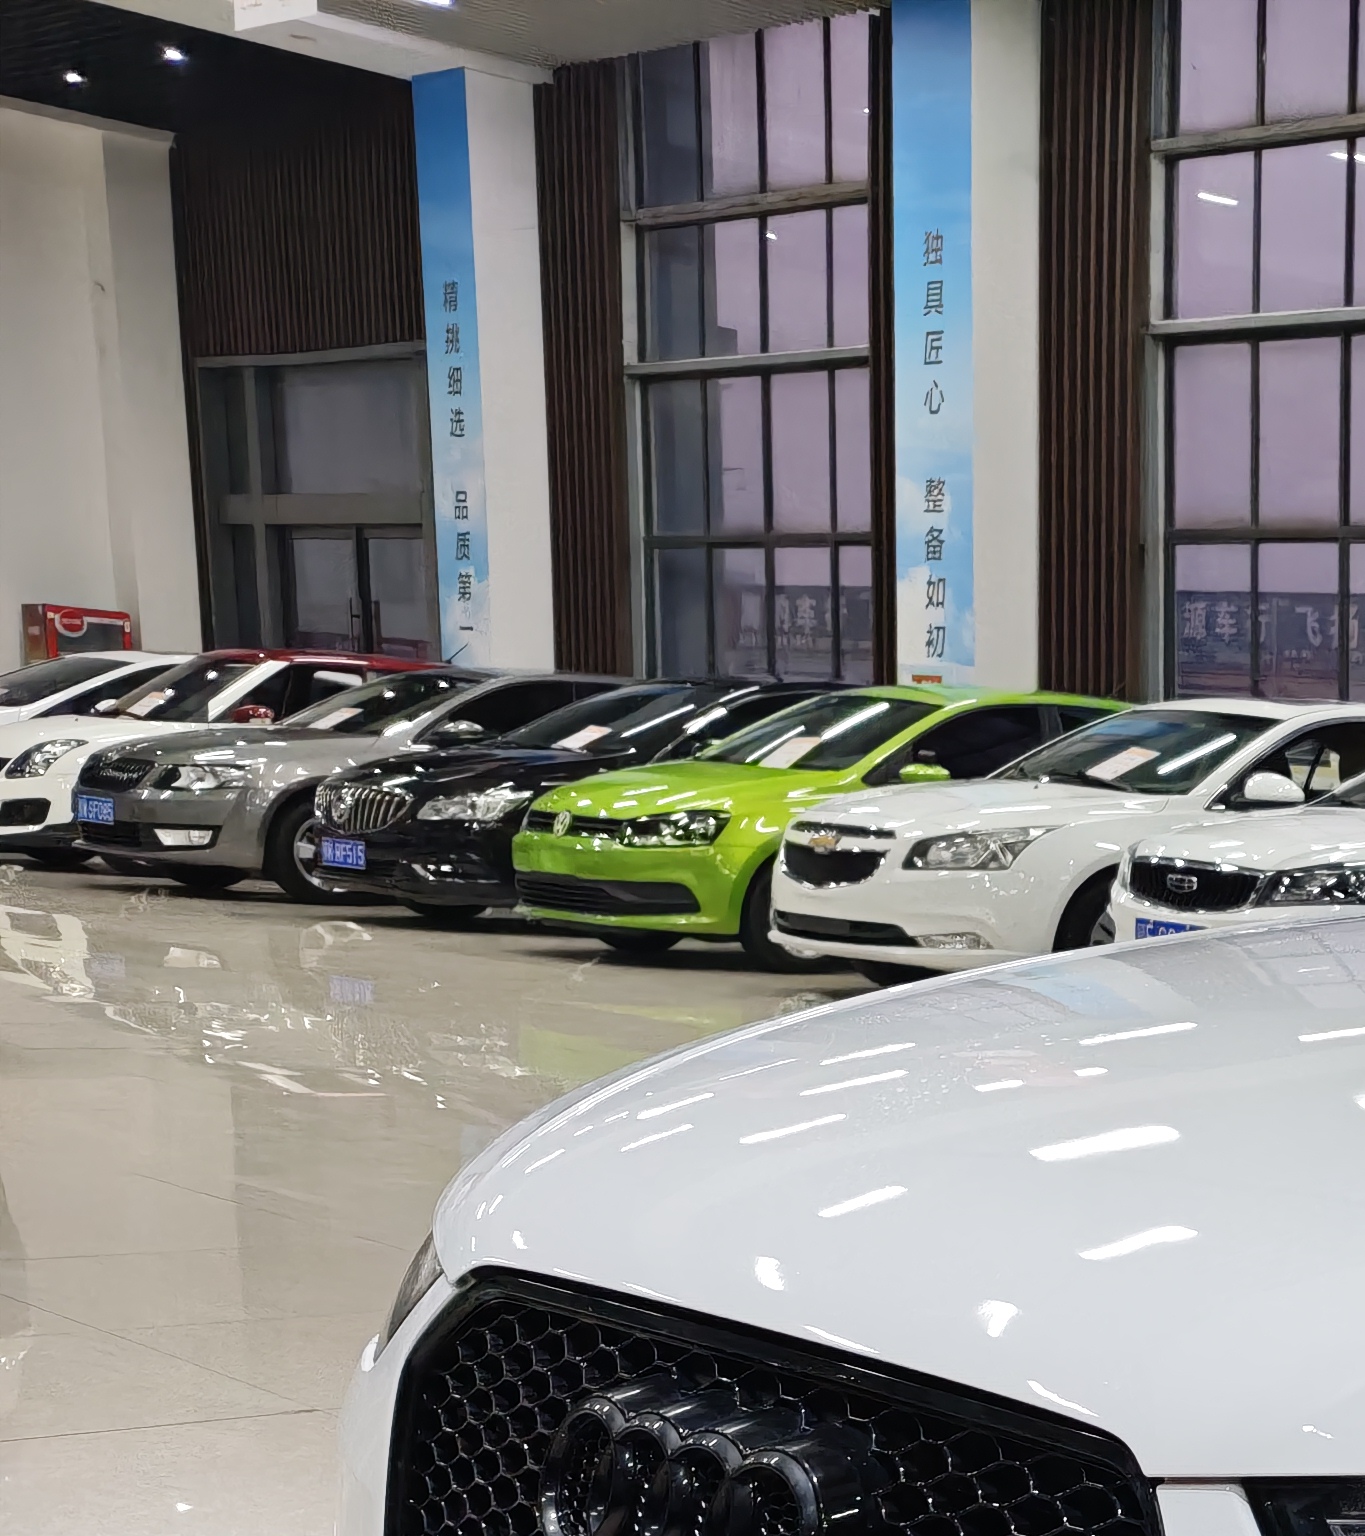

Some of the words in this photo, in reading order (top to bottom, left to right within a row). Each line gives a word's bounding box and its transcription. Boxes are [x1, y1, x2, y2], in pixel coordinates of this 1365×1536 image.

[922, 229, 945, 415] 独具匠心
[442, 280, 466, 438] 精挑细选
[454, 490, 475, 632] 品质第一
[923, 477, 946, 659] 整备如初
